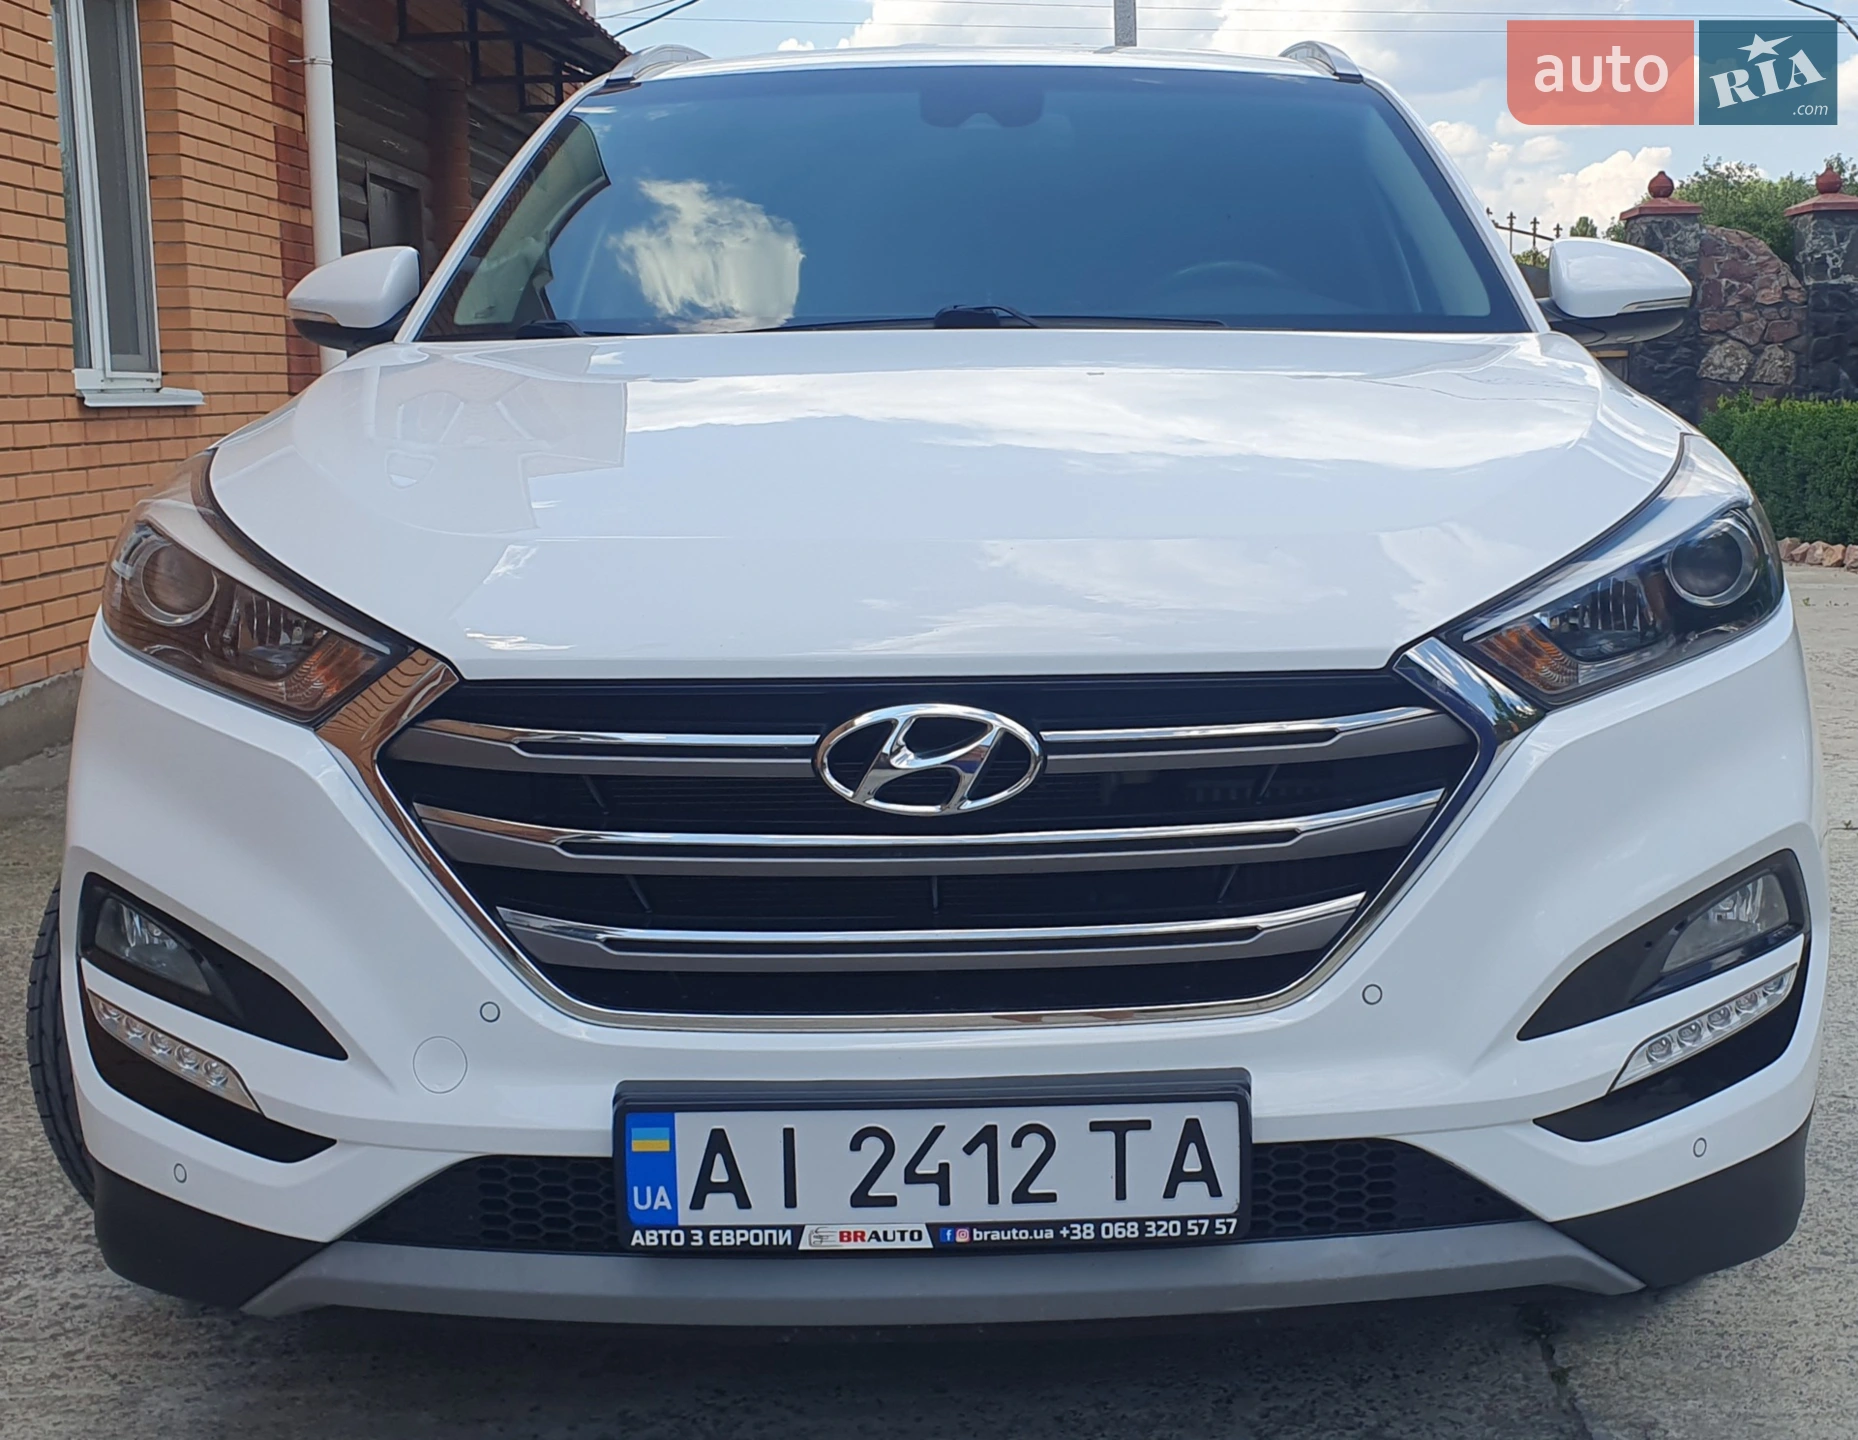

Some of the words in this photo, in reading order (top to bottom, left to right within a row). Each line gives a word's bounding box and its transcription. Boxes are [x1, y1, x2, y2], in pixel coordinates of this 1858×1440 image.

[689, 1126, 798, 1211] AI
[848, 1123, 1058, 1208] 2412
[1088, 1117, 1223, 1201] TA
[632, 1186, 672, 1211] UA
[630, 1229, 684, 1247] АВТО
[708, 1228, 793, 1246] ЄВРОПИ
[838, 1228, 924, 1243] BRAUTO
[972, 1226, 1055, 1242] brauto.ua
[1059, 1223, 1095, 1240] +38
[1100, 1221, 1140, 1239] 068
[1144, 1220, 1182, 1238] 320
[1186, 1219, 1210, 1236] 57
[1214, 1217, 1238, 1235] 57
